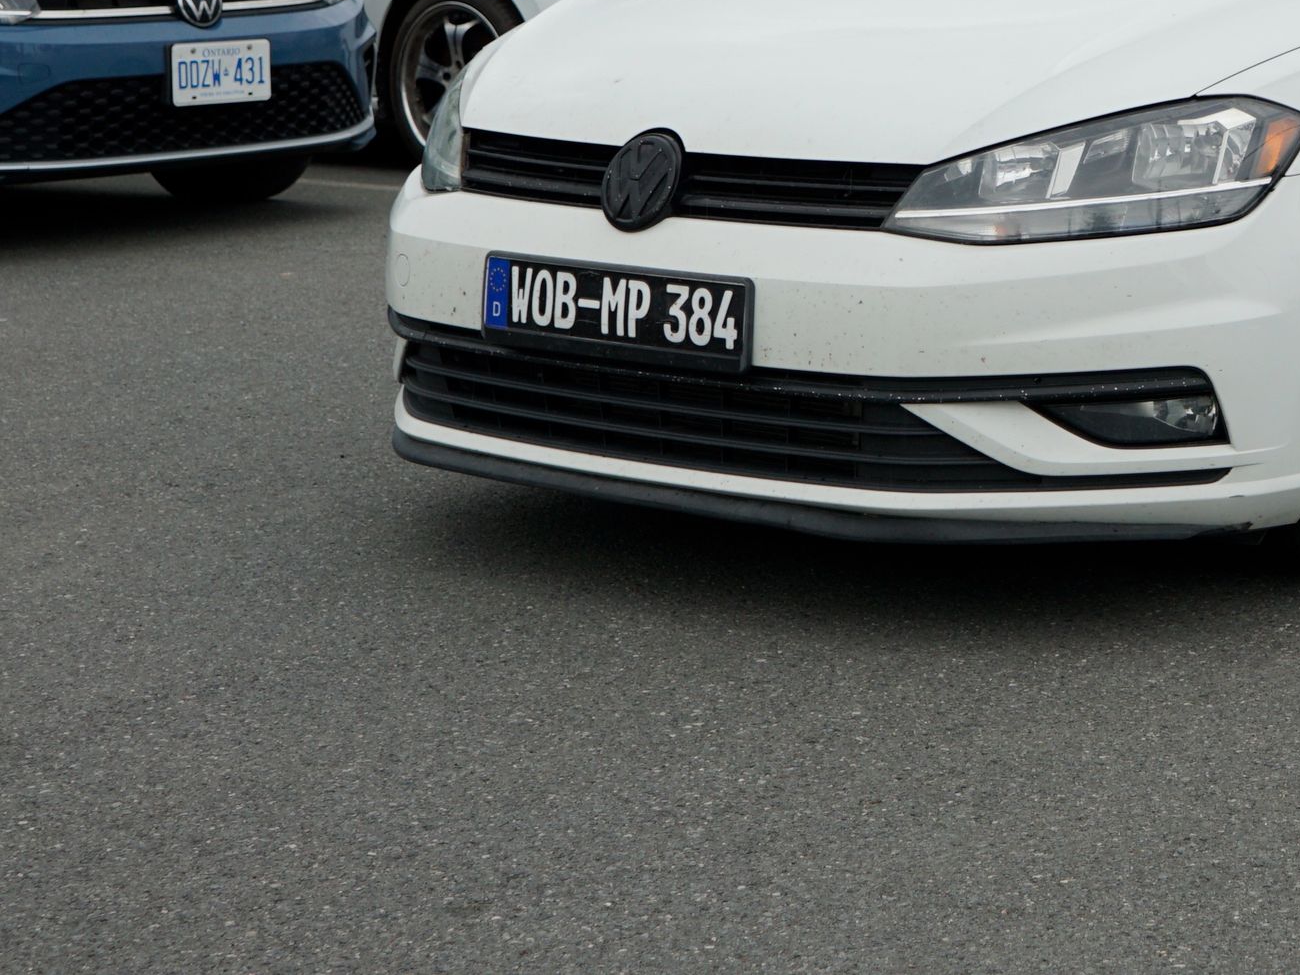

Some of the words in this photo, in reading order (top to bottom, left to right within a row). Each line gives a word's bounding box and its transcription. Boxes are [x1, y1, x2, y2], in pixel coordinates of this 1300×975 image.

[202, 48, 240, 58] ONTARIO
[234, 56, 265, 86] 431
[492, 301, 501, 317] D
[510, 265, 651, 339] WOB-MP
[662, 283, 738, 351] 384
